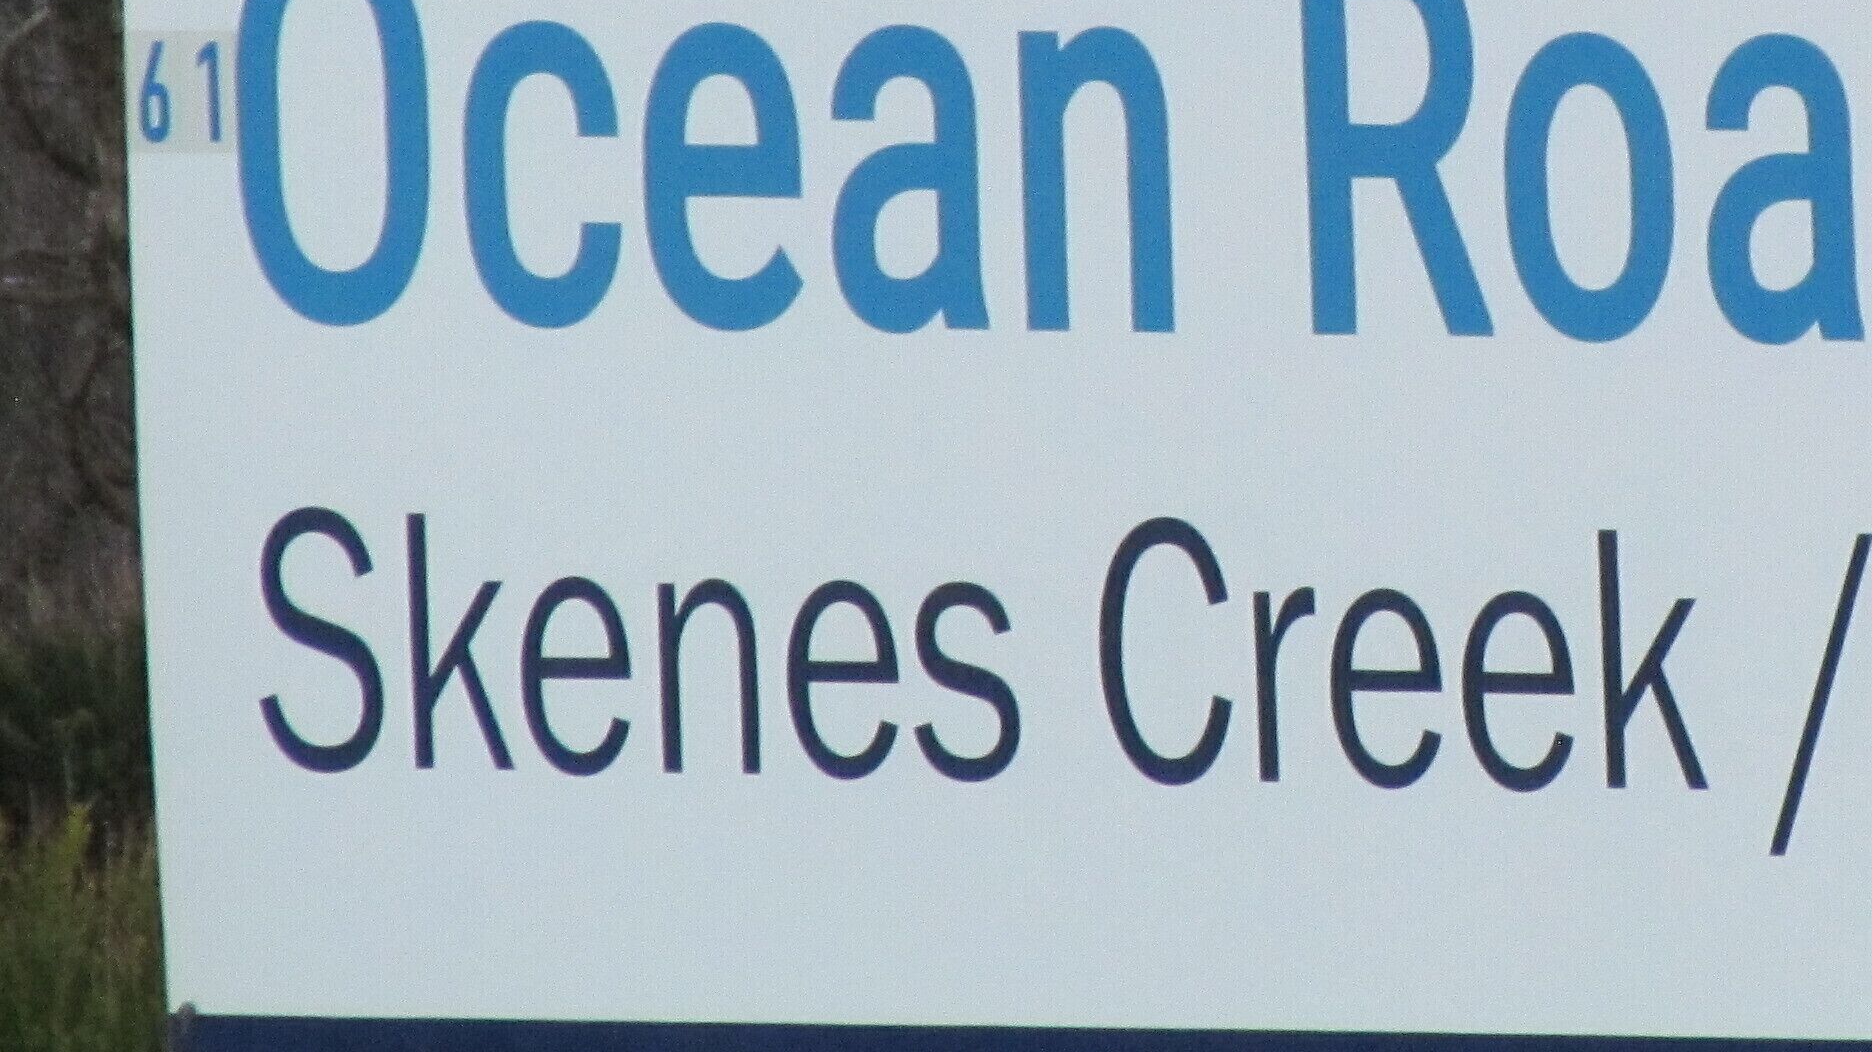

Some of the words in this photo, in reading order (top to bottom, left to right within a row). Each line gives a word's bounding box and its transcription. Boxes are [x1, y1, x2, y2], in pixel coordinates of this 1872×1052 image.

[137, 39, 222, 145] 61
[258, 505, 1022, 783] Skenes
[1098, 516, 1709, 793] Creek
